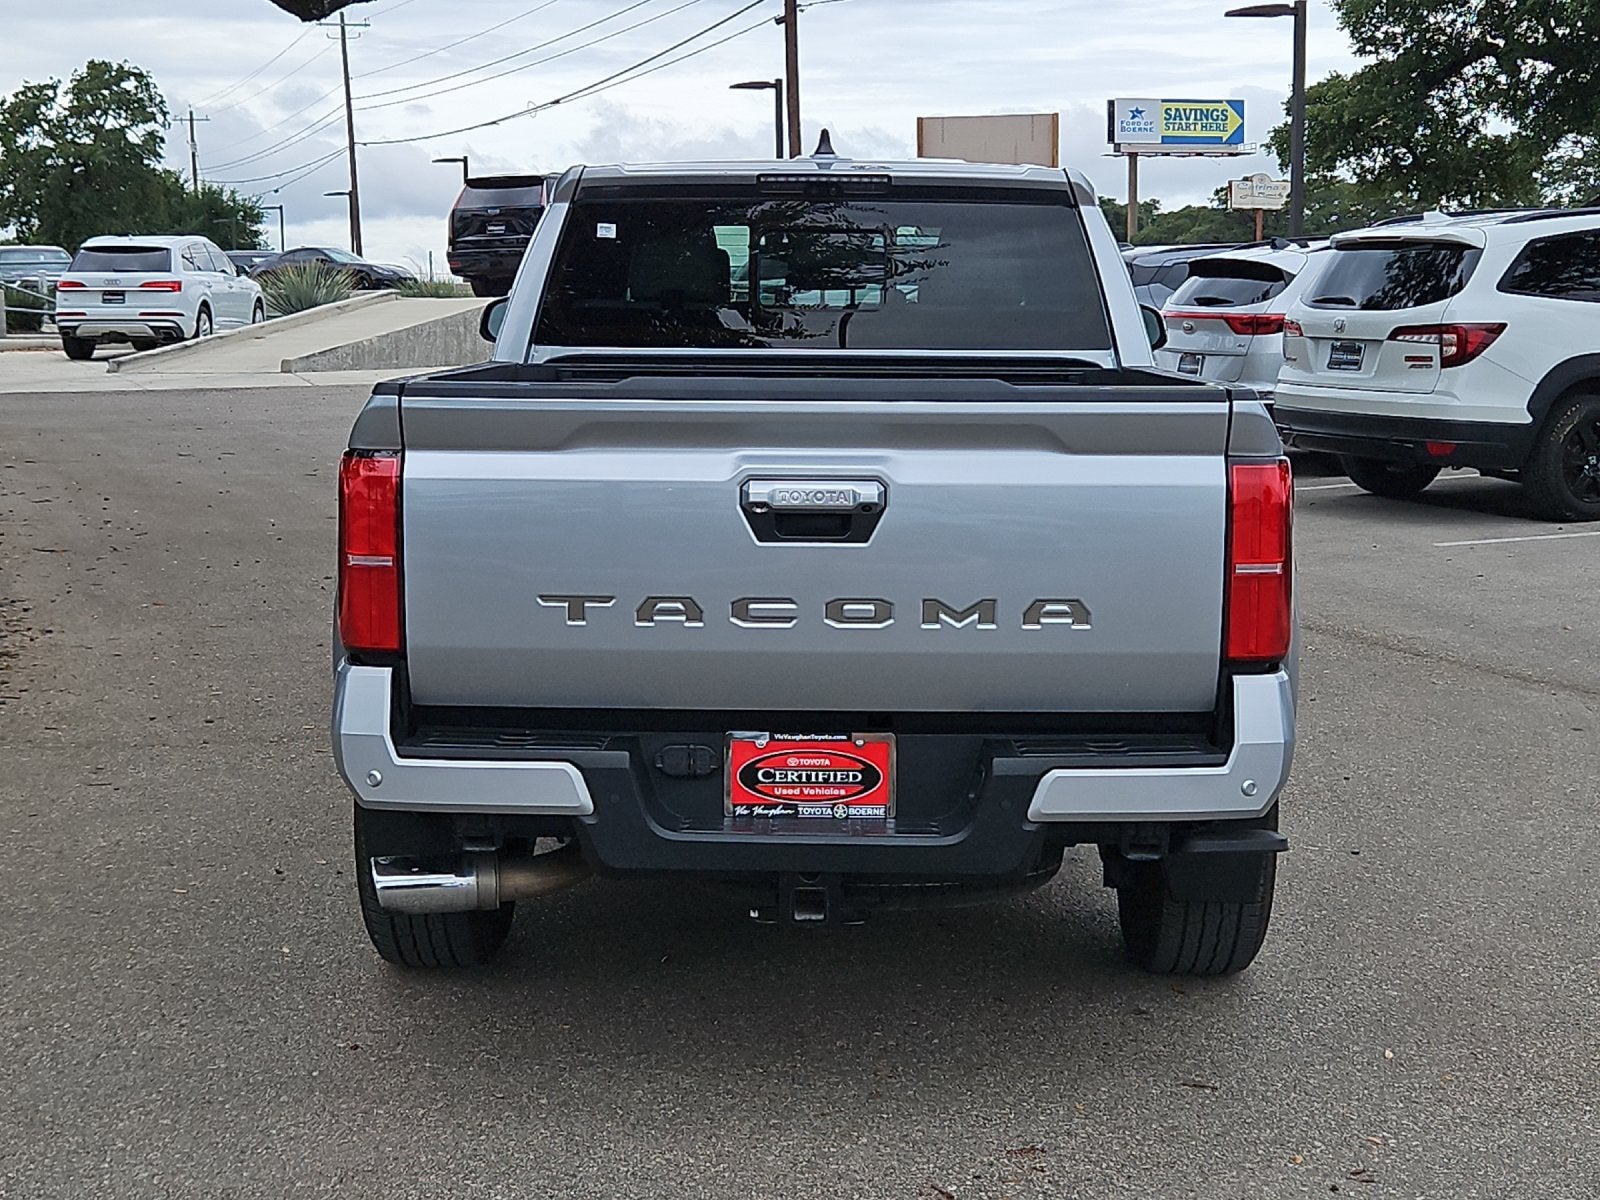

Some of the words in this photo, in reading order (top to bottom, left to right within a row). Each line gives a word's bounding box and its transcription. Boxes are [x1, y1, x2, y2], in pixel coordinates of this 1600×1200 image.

[1164, 107, 1229, 122] SAVINGS
[1164, 122, 1199, 132] START
[1200, 122, 1229, 132] HERE
[778, 490, 849, 504] TOYOTA
[536, 594, 1093, 630] TACOMA
[800, 758, 831, 766] TOYOTA
[757, 768, 862, 783] CERTIFIED
[774, 786, 800, 795] Used
[802, 786, 846, 796] Vehicles
[797, 807, 833, 815] TOYOTA
[849, 807, 886, 816] BOERNE
